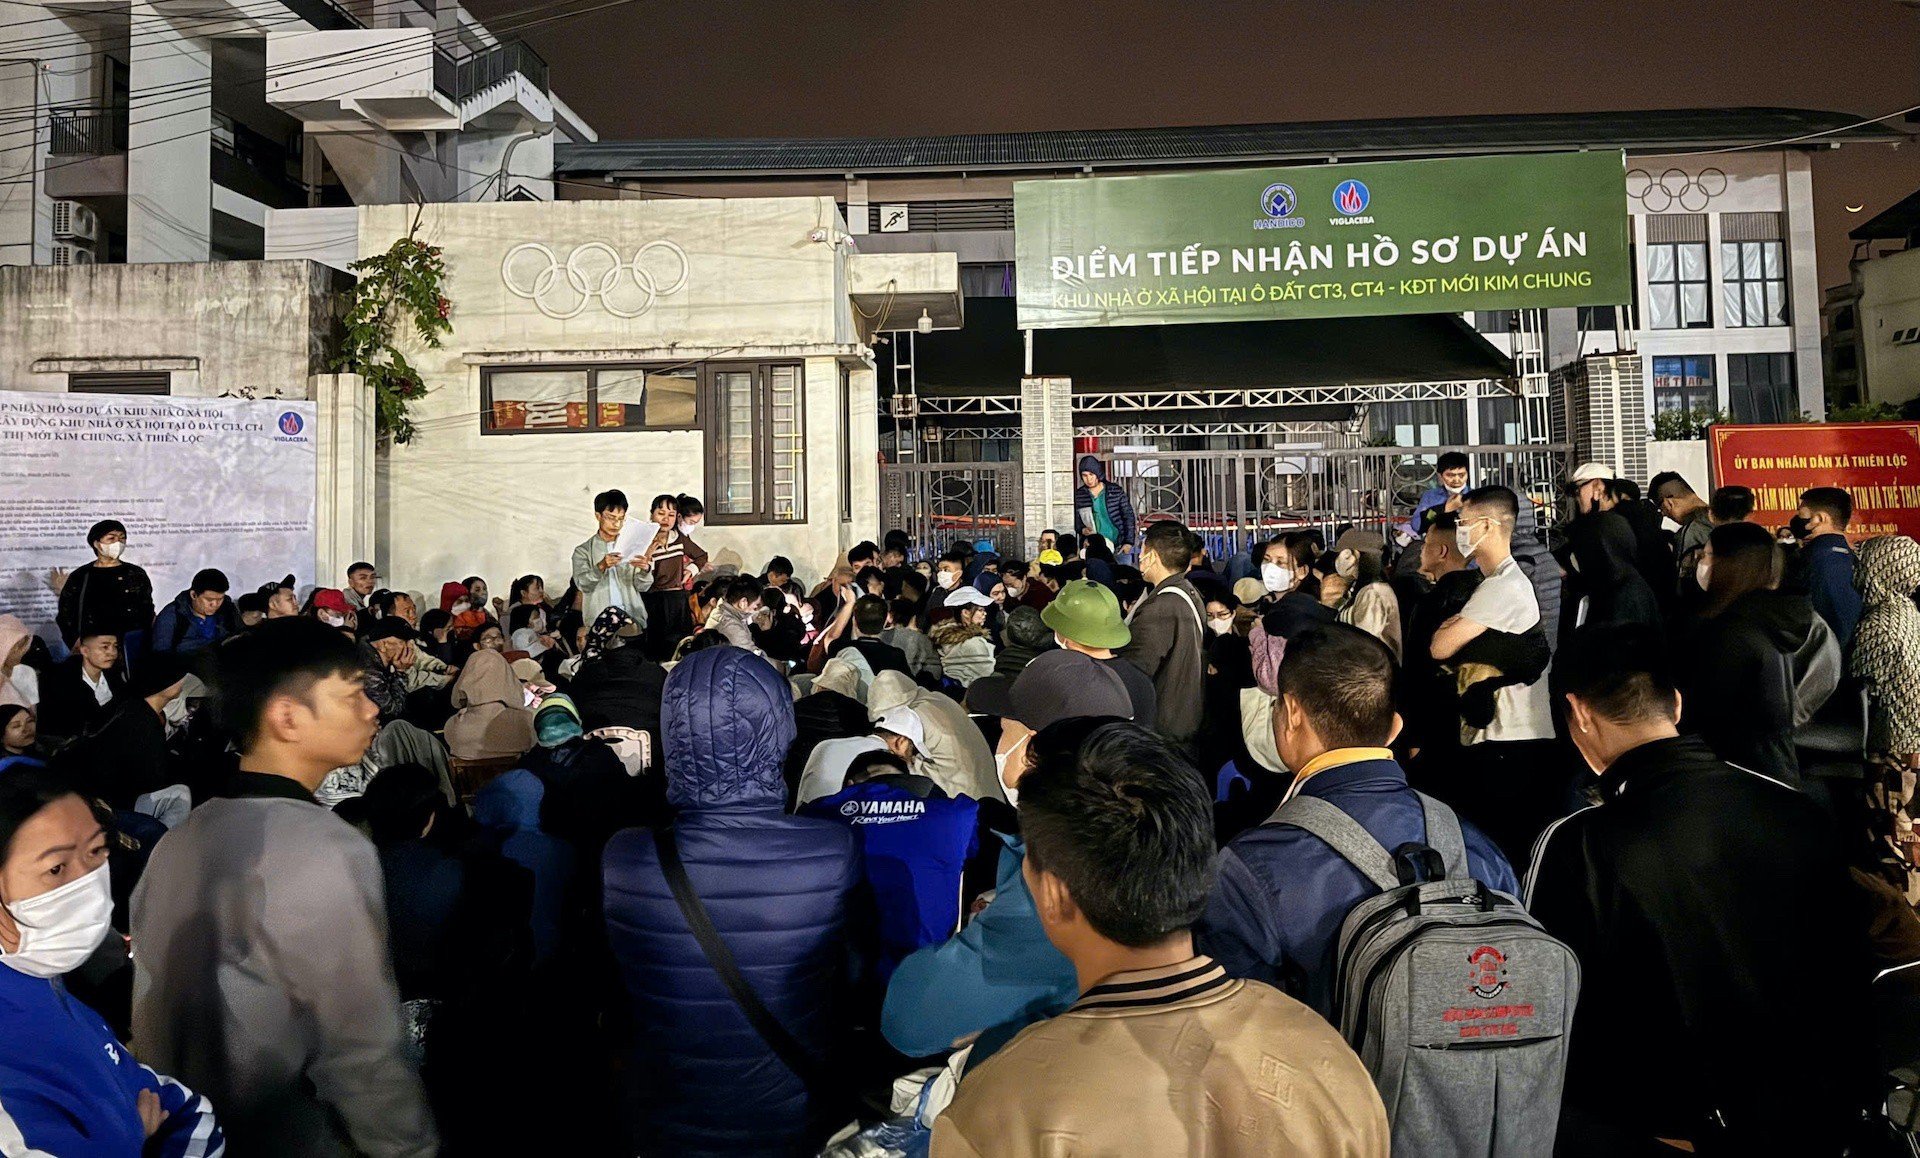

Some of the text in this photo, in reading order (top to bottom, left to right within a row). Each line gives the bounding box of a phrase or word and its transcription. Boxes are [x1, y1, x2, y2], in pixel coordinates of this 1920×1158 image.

[1253, 217, 1305, 230] HANDICO
[1329, 216, 1374, 226] VIGLACERA
[1051, 226, 1587, 286] ĐIỂM TIẾP NHẬN HỒ SƠ DỰ ÁN
[1053, 292, 1090, 308] KHU
[1095, 288, 1134, 307] NHÀ
[1137, 288, 1152, 305] Ở
[1156, 287, 1180, 305] XÃ
[1184, 285, 1216, 306] HỘI
[1220, 287, 1246, 306] TẠI
[1250, 283, 1266, 302] Ô
[1269, 281, 1305, 301] ĐẤT
[1309, 283, 1347, 300] CT3,
[1351, 281, 1385, 298] CT4
[1400, 278, 1437, 295] KĐT
[1441, 273, 1479, 293] MỚI
[1484, 274, 1518, 291] KIM
[1523, 271, 1592, 289] CHUNG
[124, 406, 148, 416] KHU
[203, 408, 223, 419] HỘI
[60, 418, 85, 427] KHU
[88, 418, 112, 428] NHÀ
[126, 419, 142, 429] XÃ
[144, 421, 164, 431] HỘI
[167, 421, 186, 432] TẠI
[245, 423, 263, 432] CT4
[3, 430, 24, 442] THỊ
[27, 429, 52, 441] MỚI
[55, 431, 78, 441] KIM
[81, 432, 125, 442] CHUNG,
[127, 432, 144, 442] XÃ
[145, 432, 179, 443] THIÊN
[1734, 452, 1908, 470] ỦY BAN NHÂN DÂN XÃ THIÊN LỘC
[1852, 486, 1870, 510] TIN
[1869, 481, 1882, 509] VÀ
[1881, 476, 1901, 509] THỂ
[861, 801, 925, 814] YAMAHA
